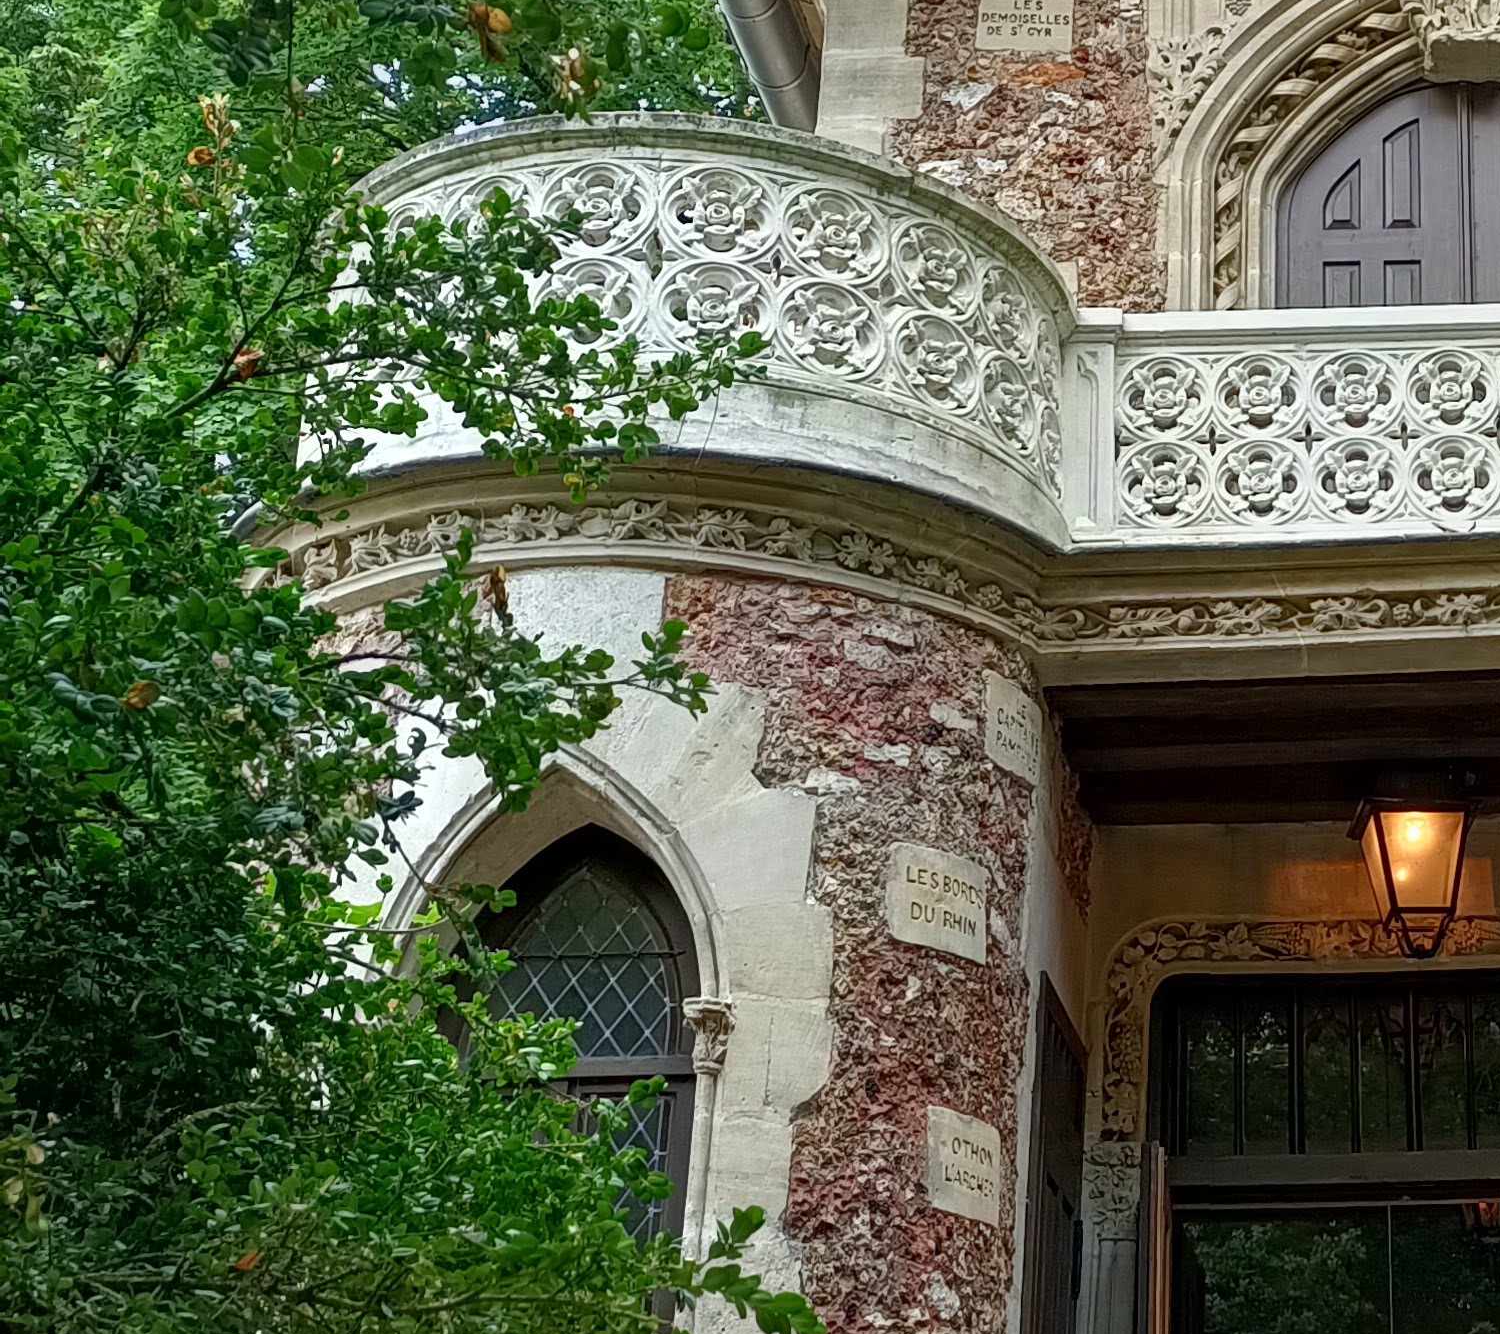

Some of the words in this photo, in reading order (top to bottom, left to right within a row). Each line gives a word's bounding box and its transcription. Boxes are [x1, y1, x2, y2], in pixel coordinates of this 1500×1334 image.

[1014, 0, 1043, 11] LES
[981, 12, 1070, 26] DEMOISELLES
[986, 25, 1003, 36] DE
[1027, 27, 1052, 37] CYR
[906, 865, 939, 889] LES
[943, 875, 984, 910] BORDS
[910, 901, 935, 923] DU
[943, 910, 977, 937] RHIN
[951, 1137, 994, 1168] OTHON
